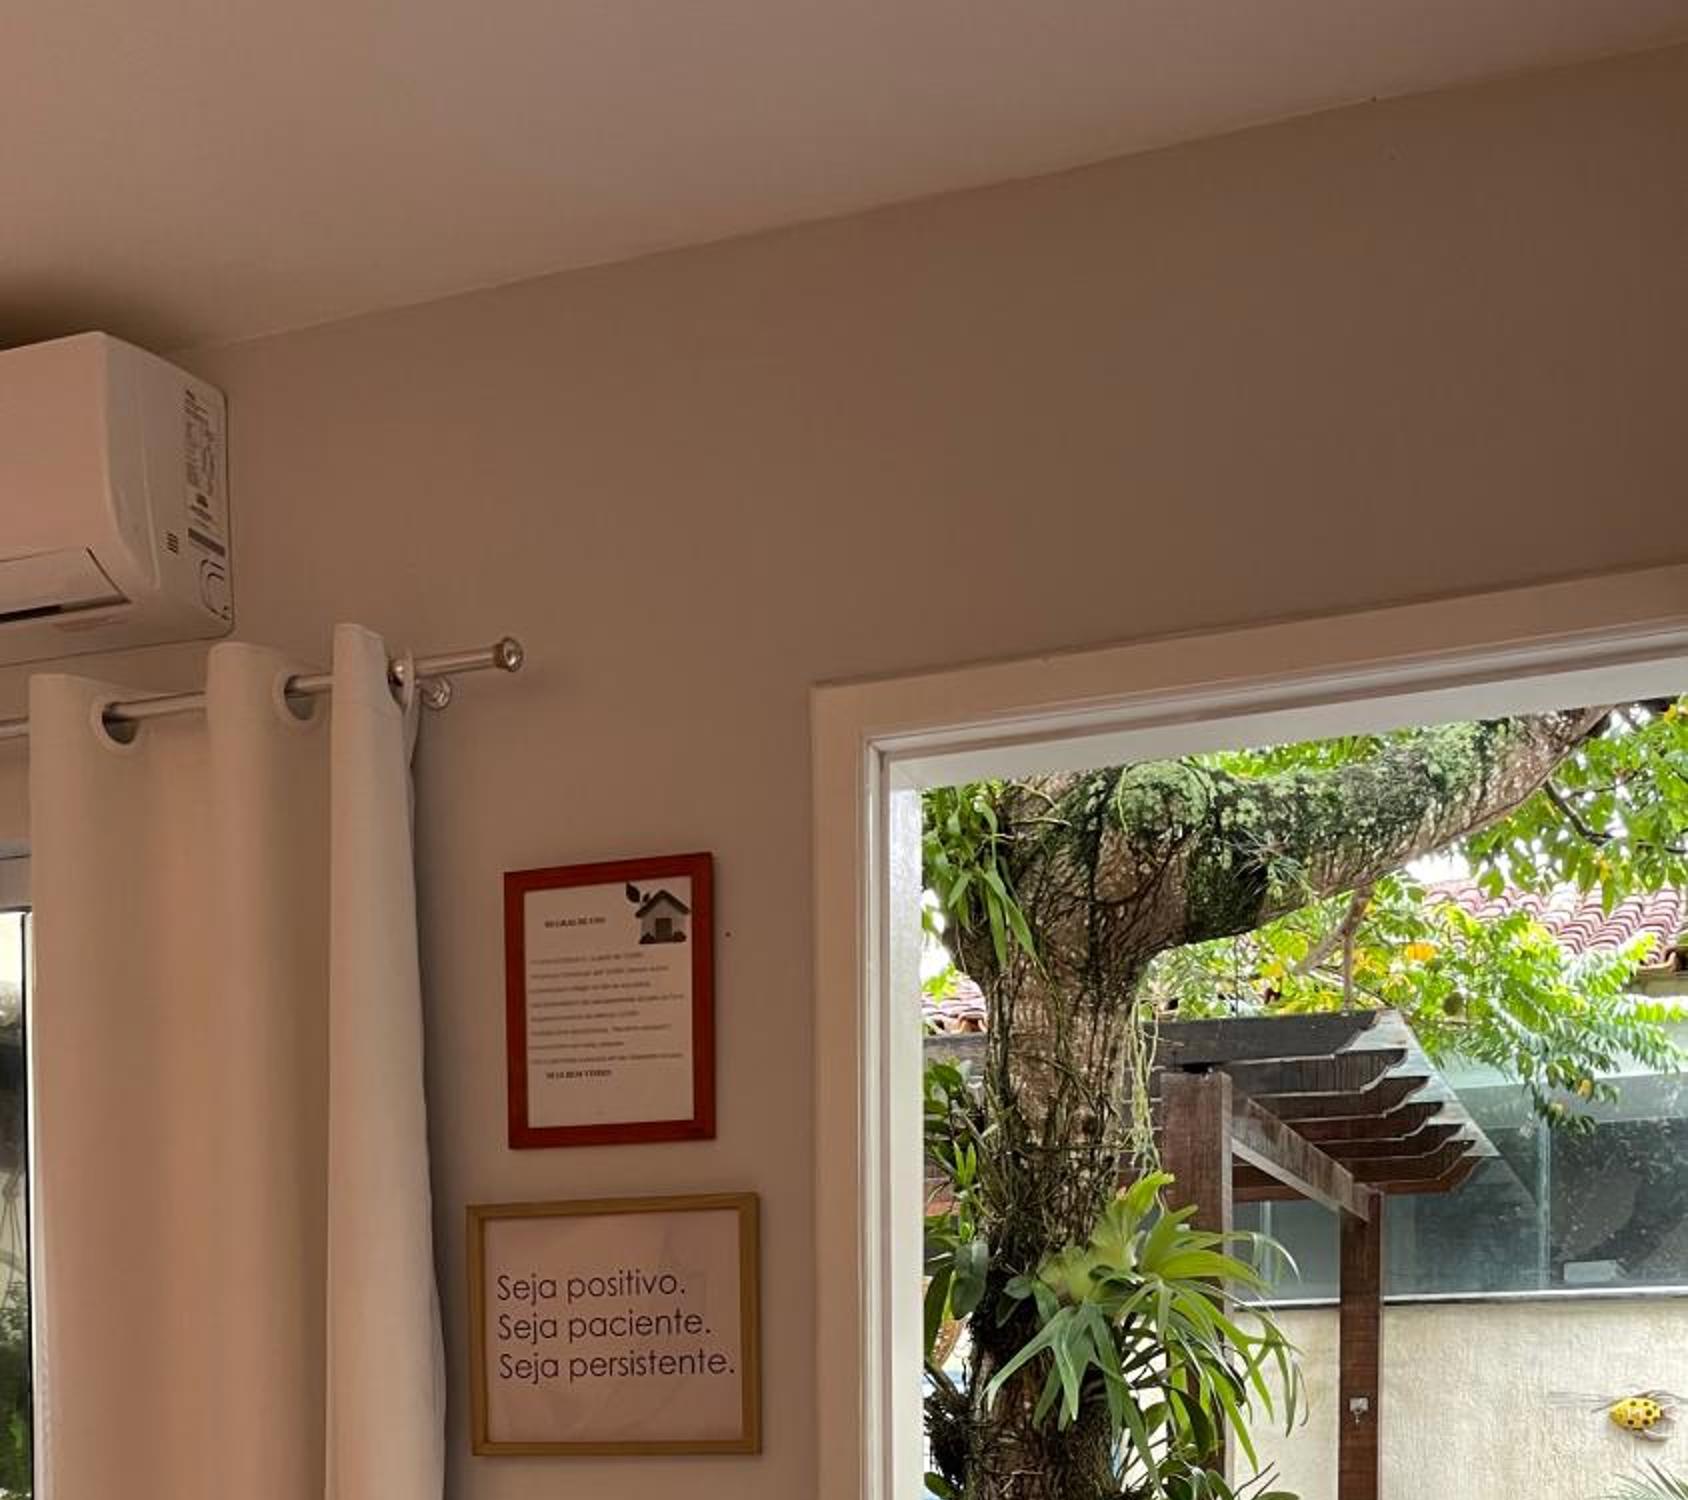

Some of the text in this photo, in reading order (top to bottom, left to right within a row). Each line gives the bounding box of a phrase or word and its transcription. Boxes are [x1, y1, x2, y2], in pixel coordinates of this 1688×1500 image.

[497, 1269, 686, 1306] Seja positivo.
[498, 1308, 712, 1345] Seja paciente.
[499, 1348, 735, 1385] Seja persistente.
